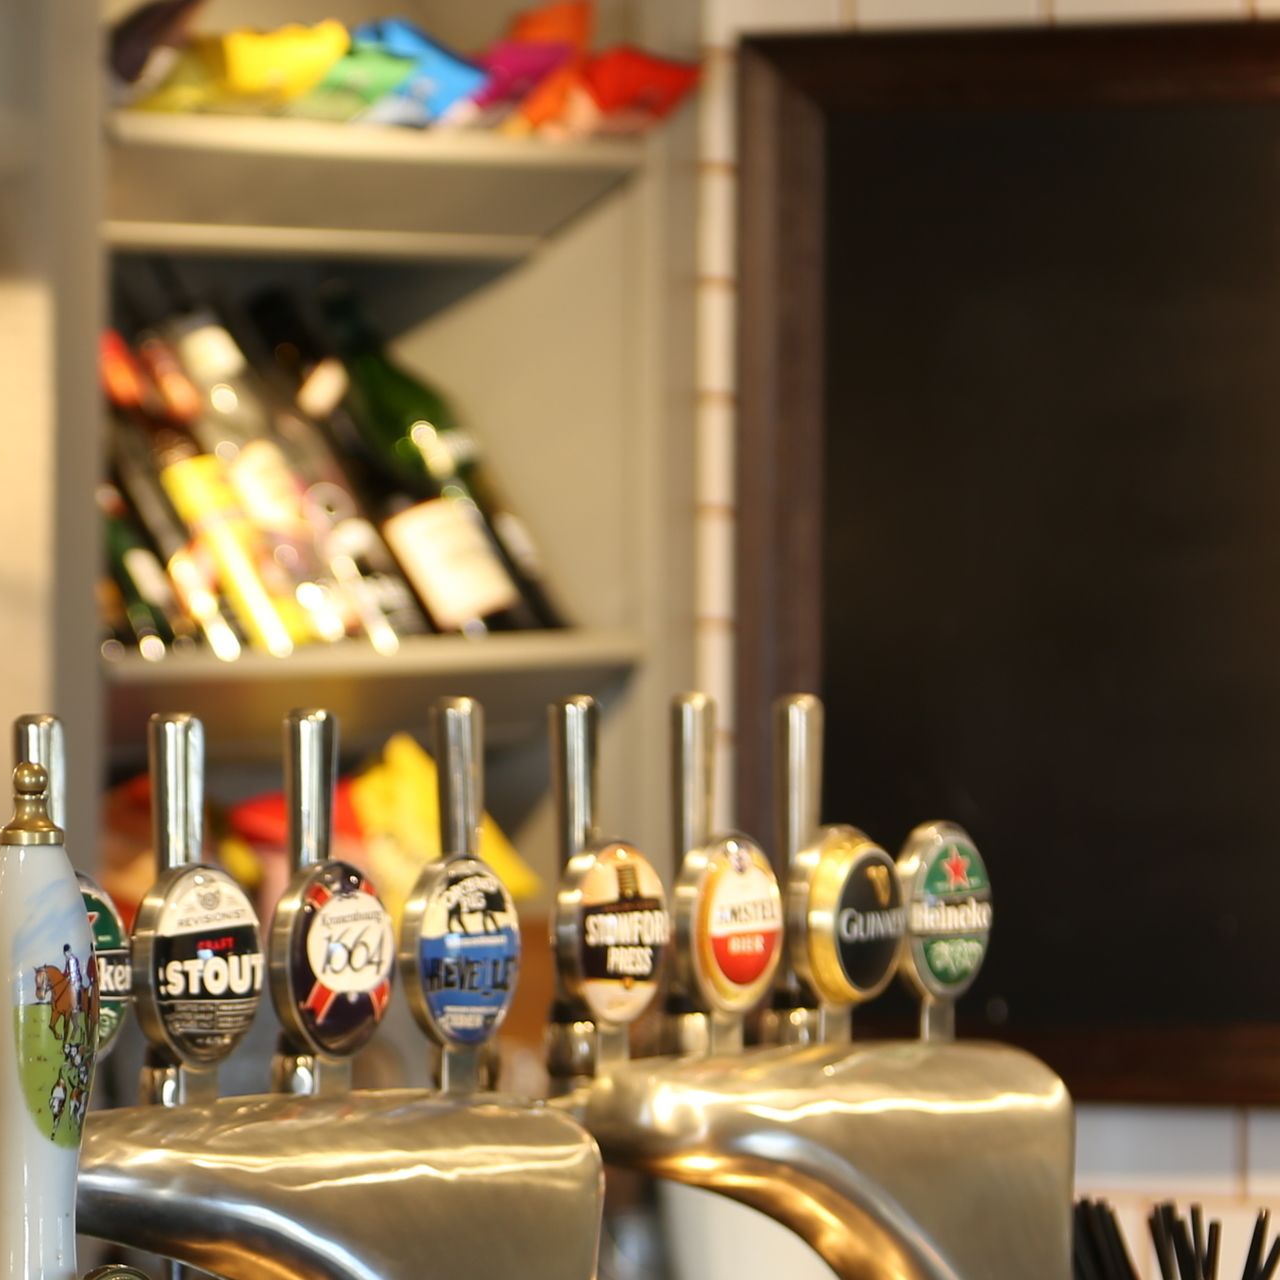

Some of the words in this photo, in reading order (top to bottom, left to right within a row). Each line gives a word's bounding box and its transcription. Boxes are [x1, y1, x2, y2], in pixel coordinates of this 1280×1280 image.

[911, 897, 991, 930] Heineke
[322, 926, 385, 976] 1664
[606, 945, 653, 976] PRESS
[728, 935, 765, 954] BIER
